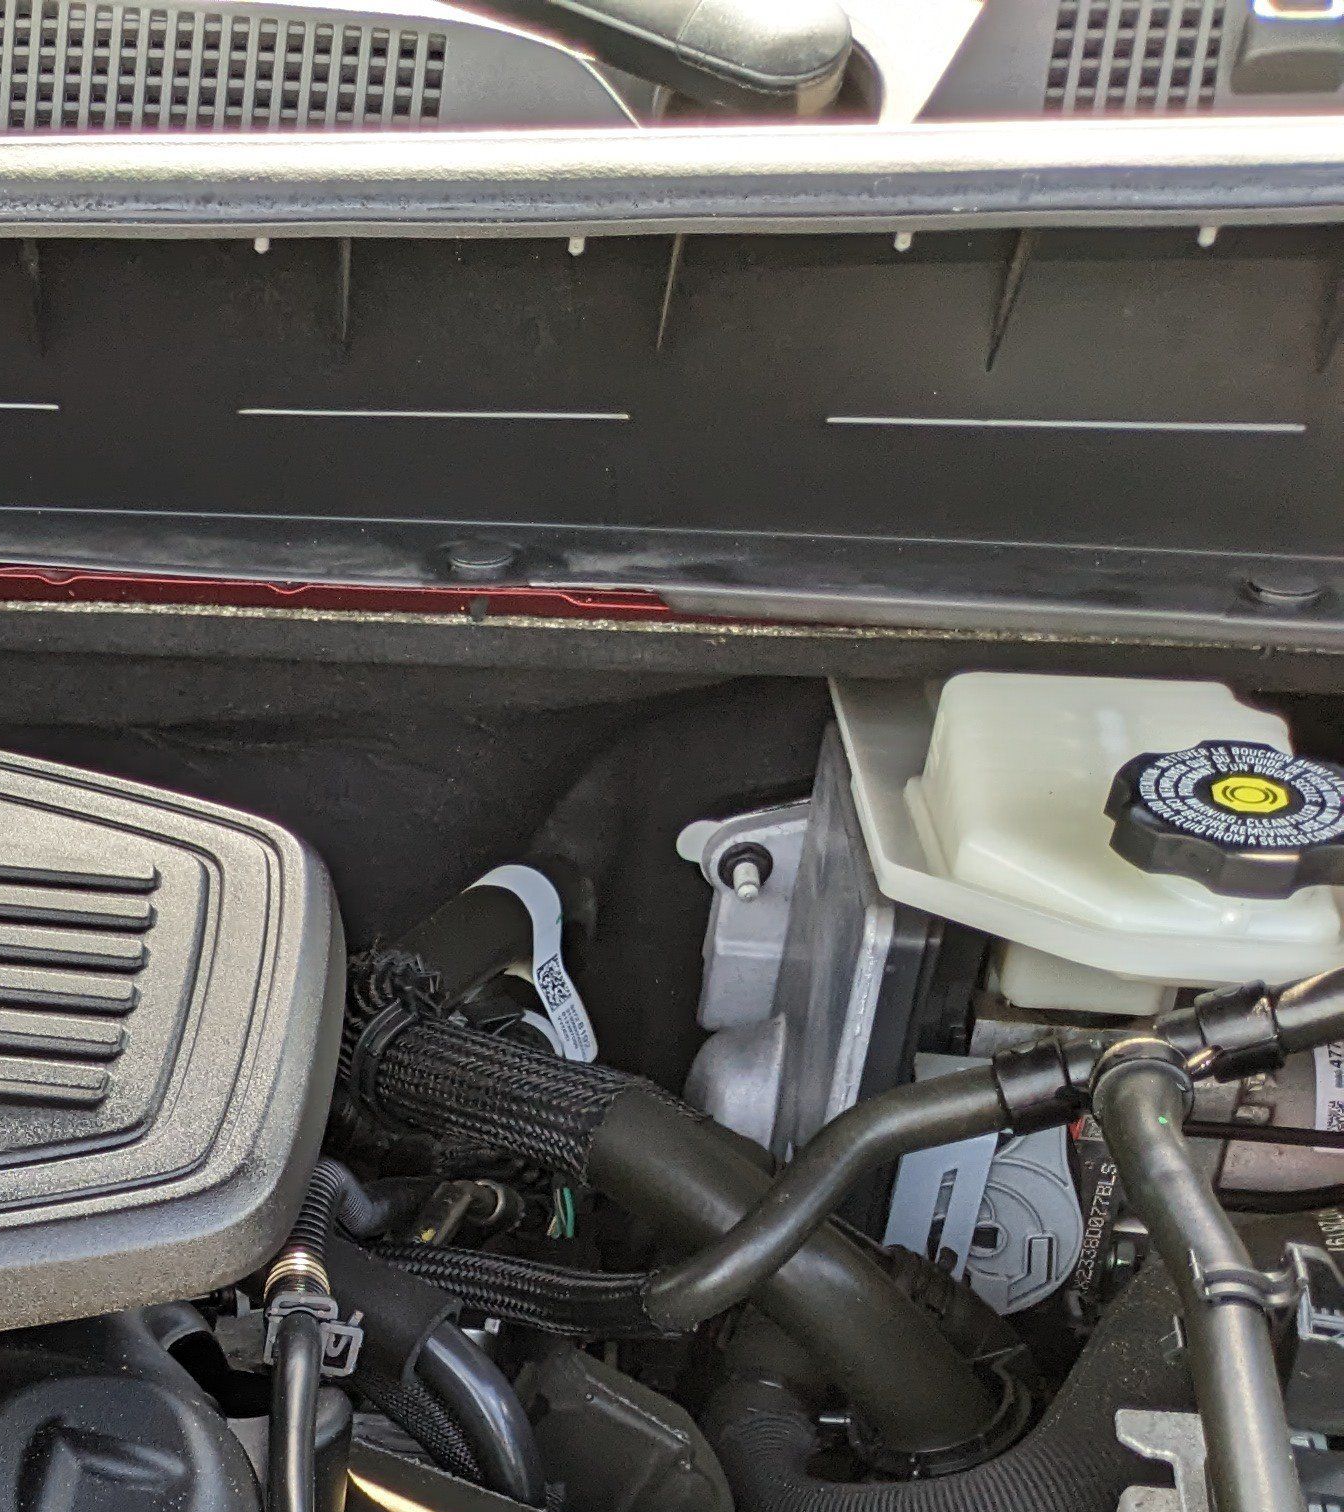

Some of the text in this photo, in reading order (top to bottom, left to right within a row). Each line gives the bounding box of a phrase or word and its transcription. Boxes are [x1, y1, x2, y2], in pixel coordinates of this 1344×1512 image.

[1210, 747, 1226, 756] LE
[1232, 747, 1294, 763] BOUCHON
[1234, 755, 1285, 769] LIQUIDE
[1253, 764, 1293, 781] BIDON
[1206, 828, 1246, 844] FROM
[1248, 836, 1257, 846] A
[1259, 834, 1310, 847] SEALED
